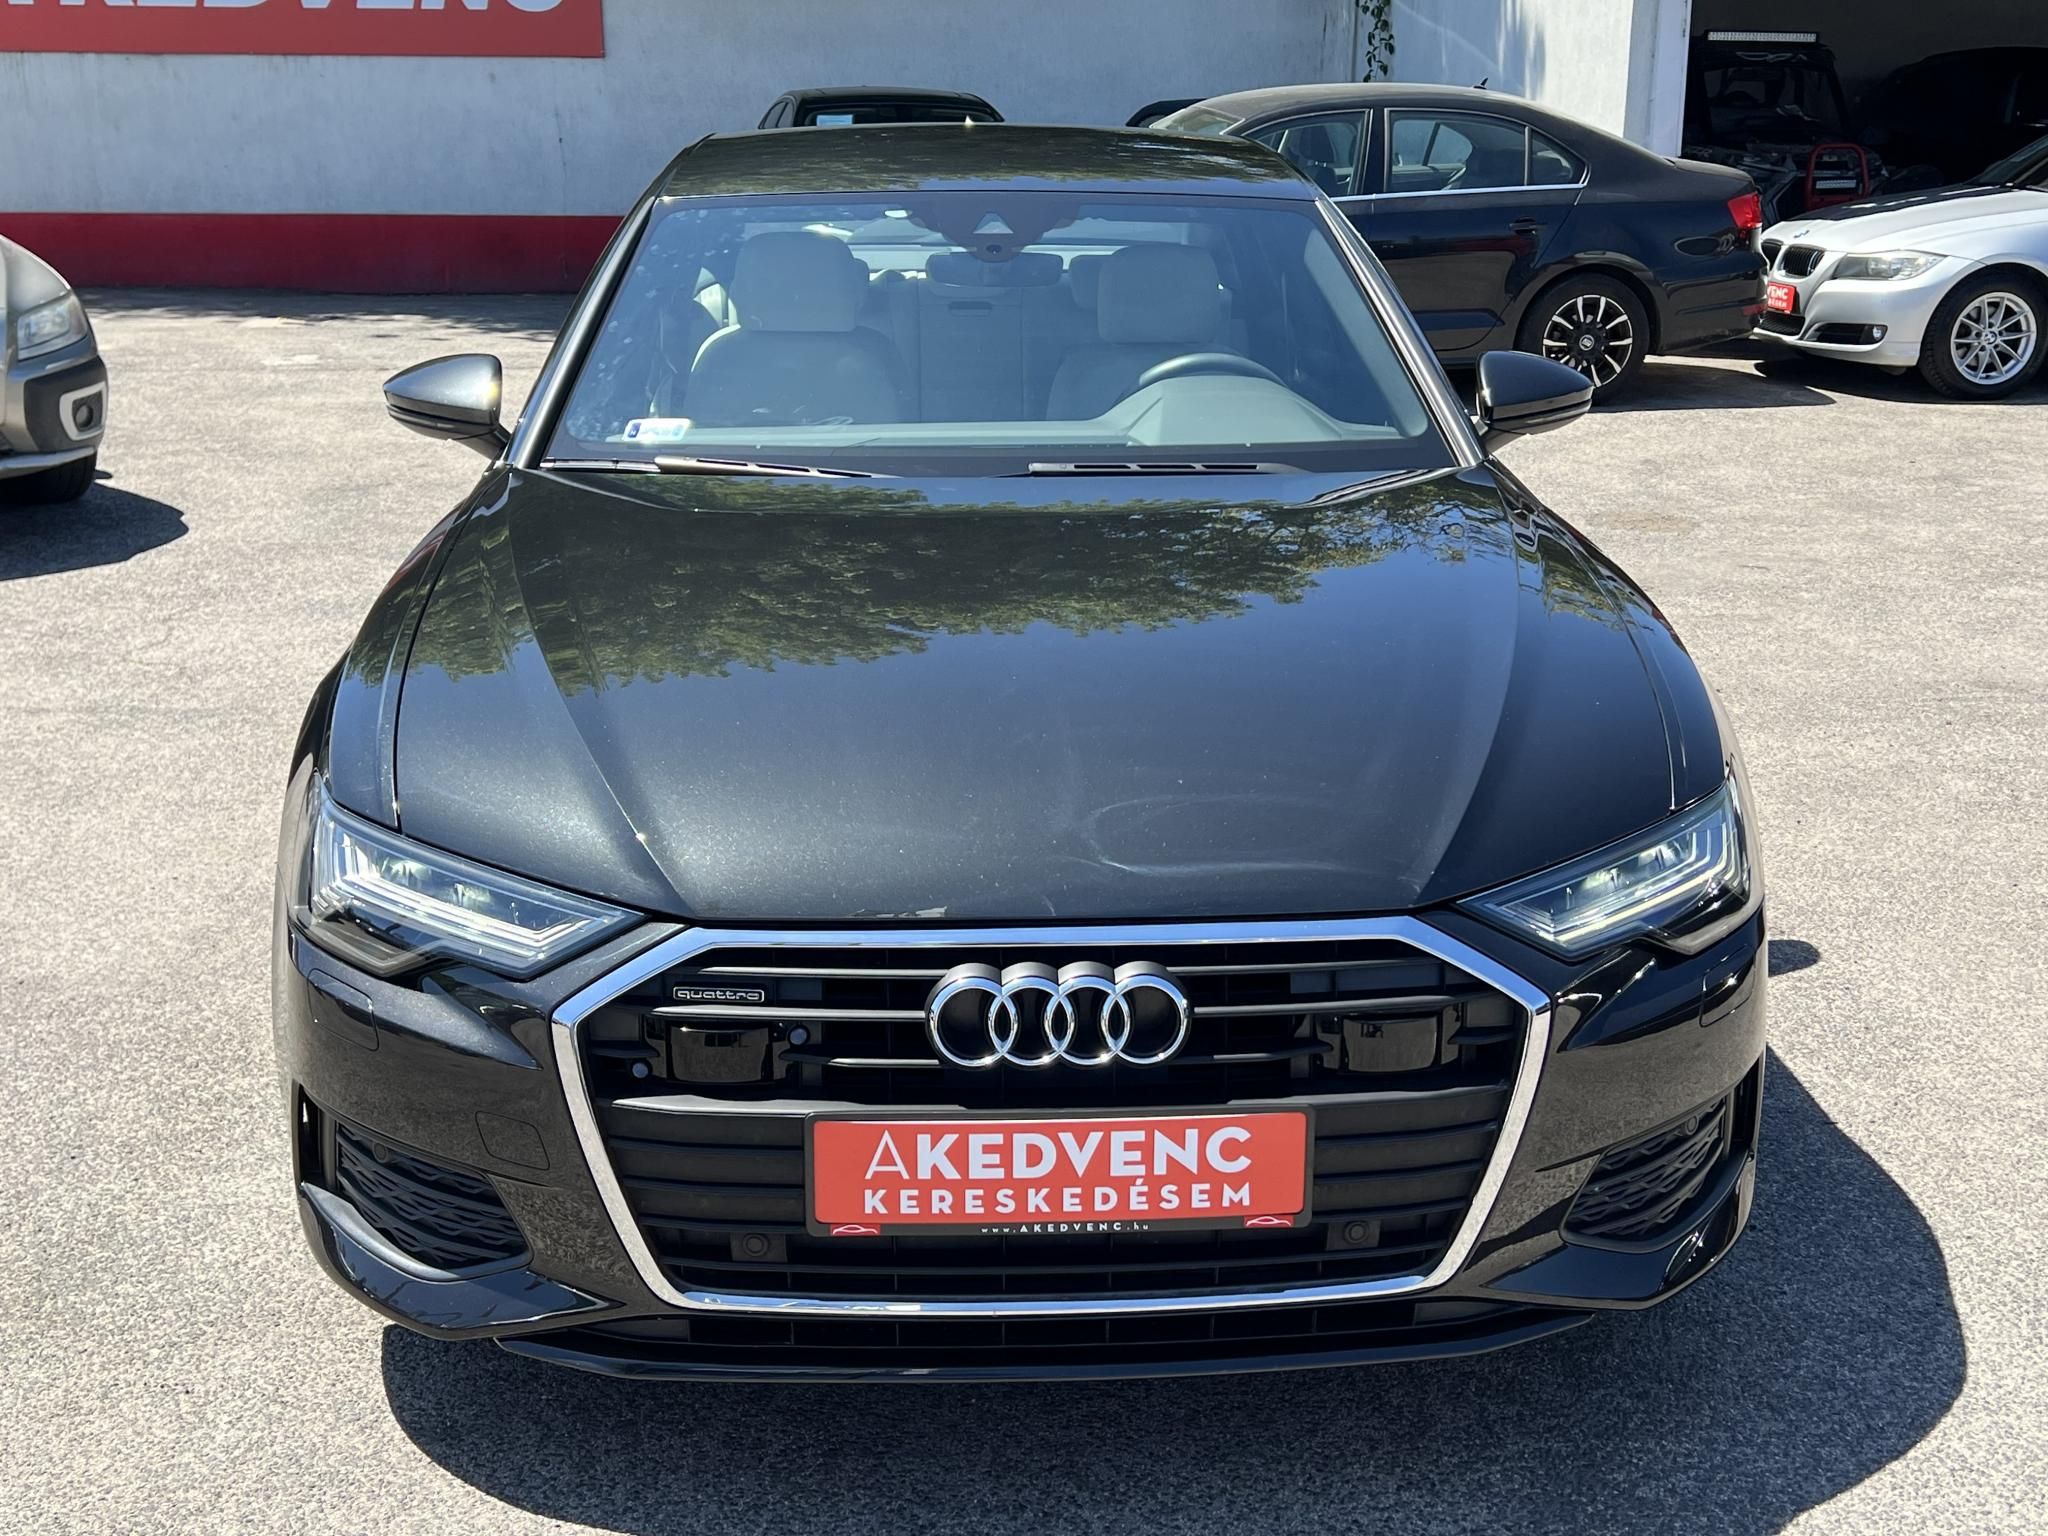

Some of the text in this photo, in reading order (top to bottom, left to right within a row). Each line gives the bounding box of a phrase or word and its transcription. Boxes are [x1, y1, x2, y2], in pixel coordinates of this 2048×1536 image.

[677, 991, 760, 1000] quattro
[865, 1126, 1252, 1180] AKEDVENC
[865, 1177, 1251, 1214] KERESKEDÉSEM
[981, 1222, 1149, 1233] www.AKEDVENC.hu
